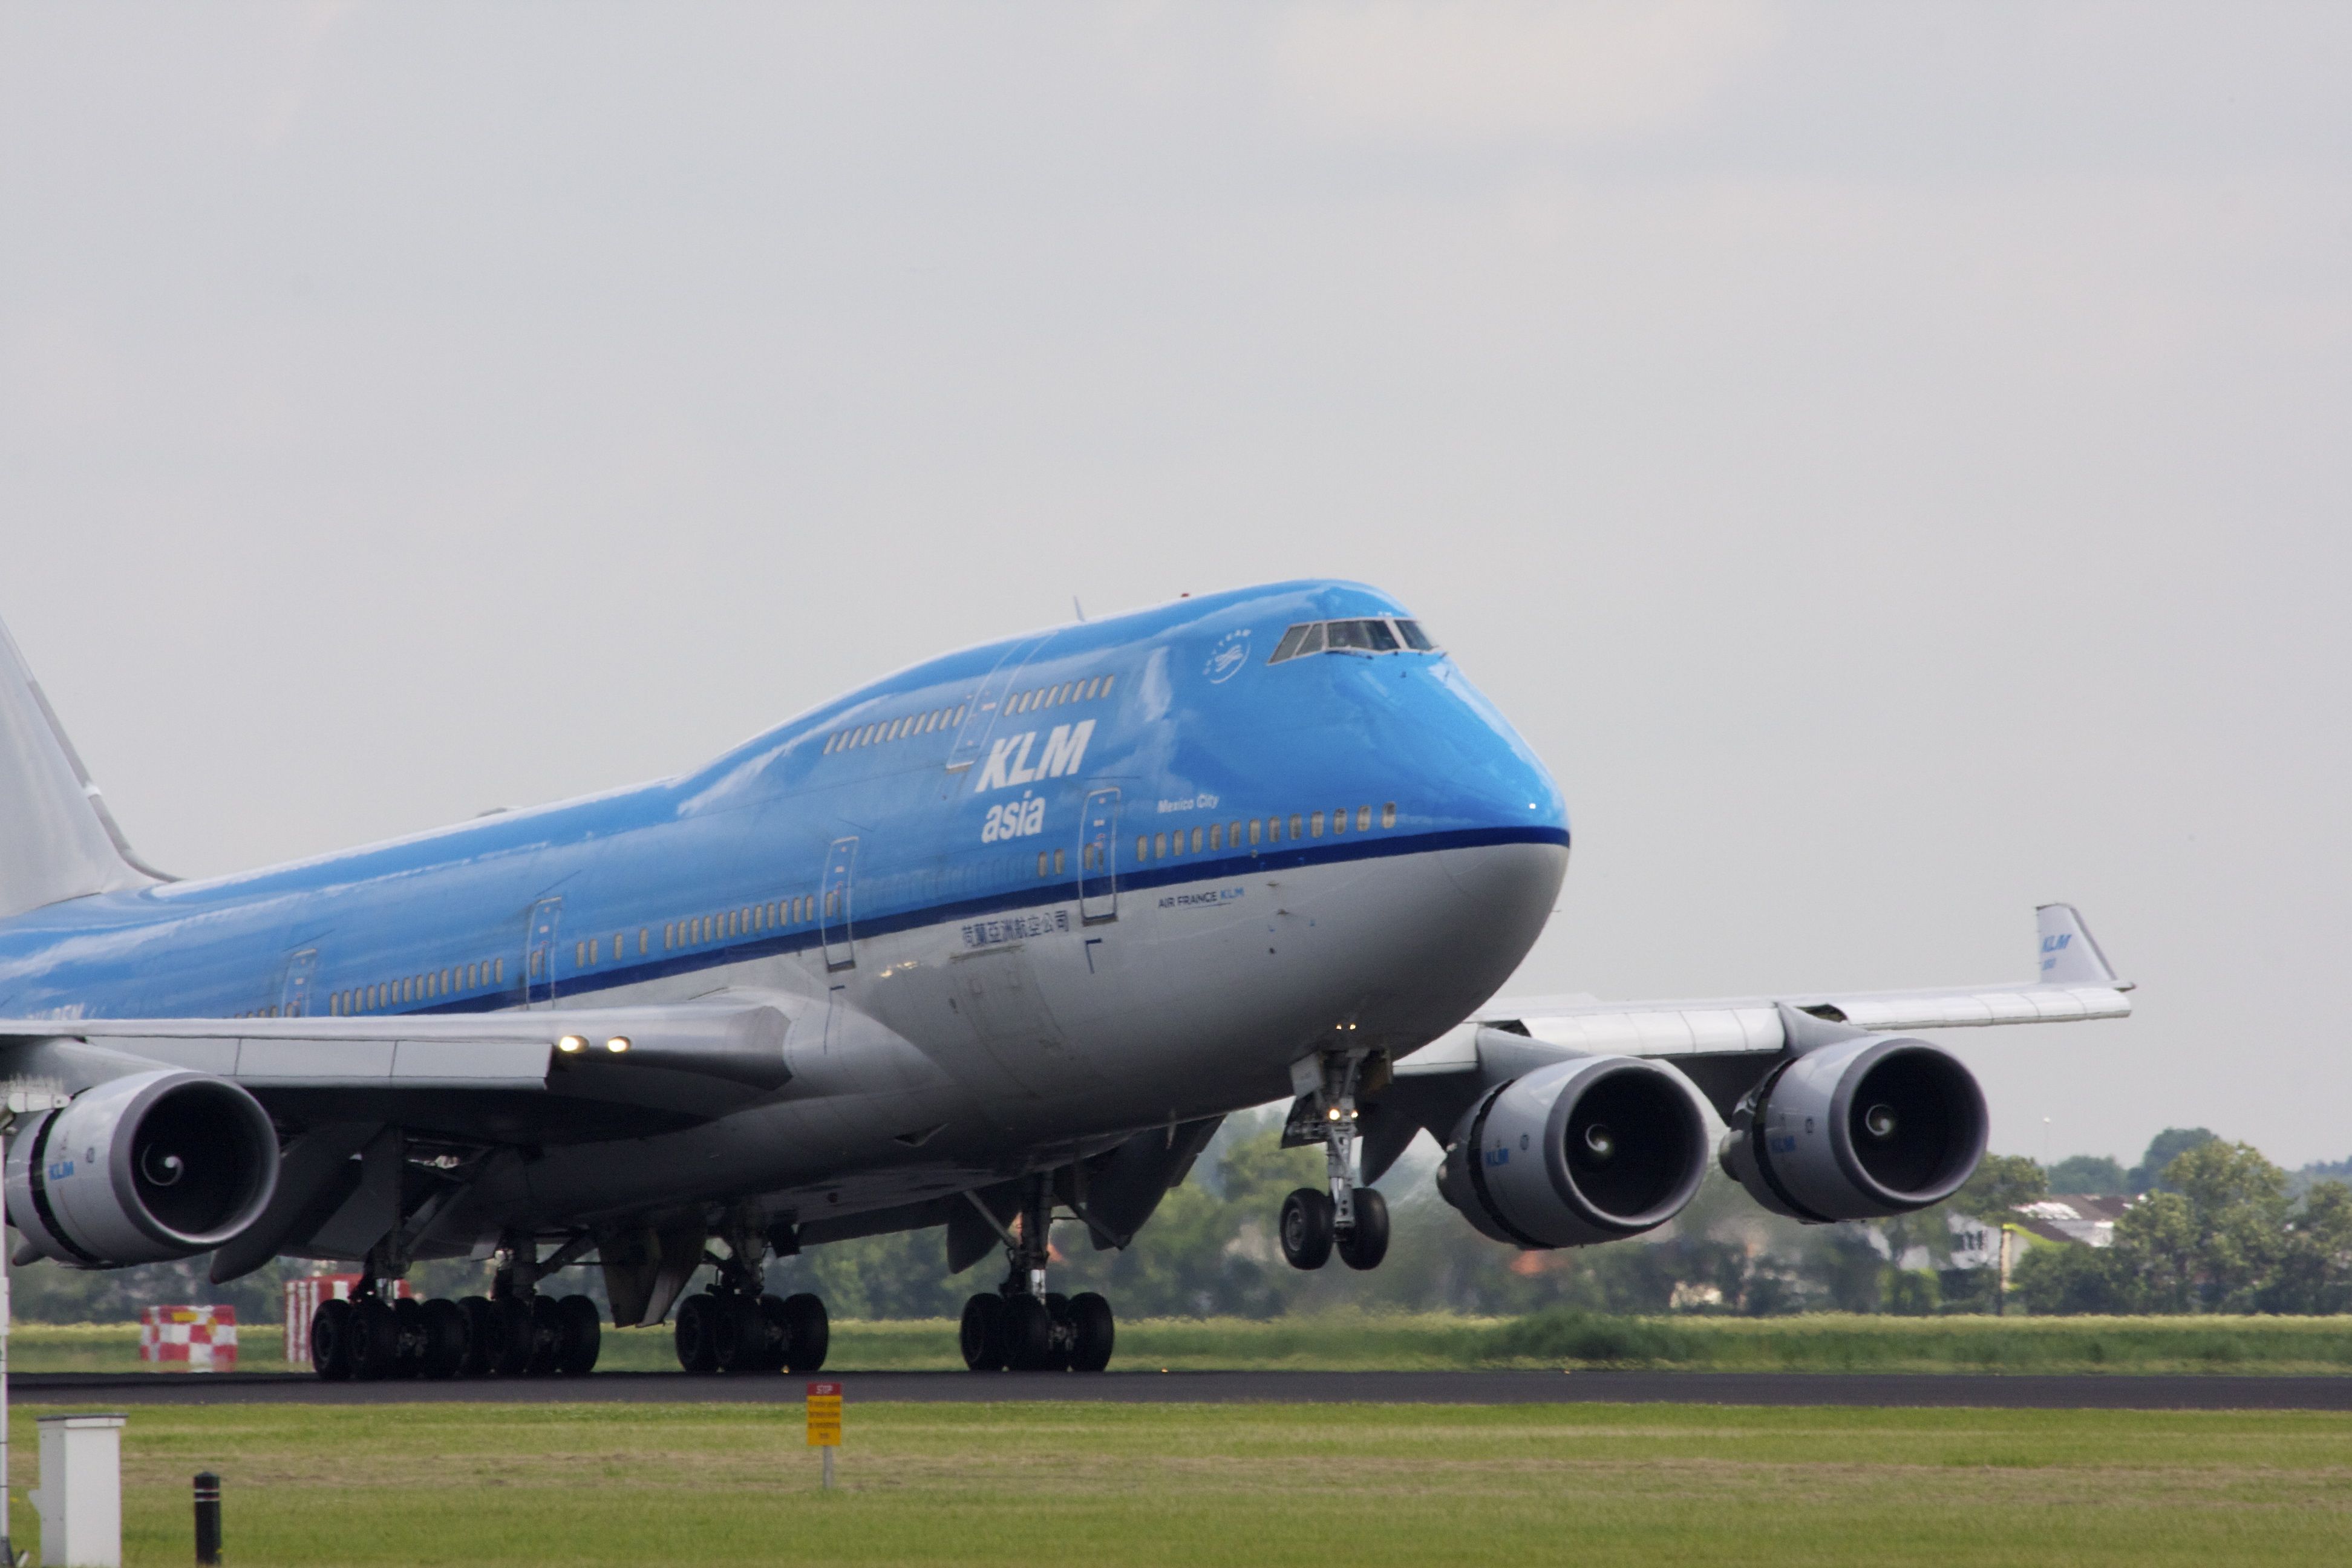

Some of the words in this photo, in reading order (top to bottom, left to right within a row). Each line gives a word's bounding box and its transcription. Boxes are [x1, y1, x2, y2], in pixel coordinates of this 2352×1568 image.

[975, 719, 1097, 793] KLM
[1157, 799, 1194, 813] Mexico
[1197, 794, 1220, 809] City
[981, 790, 1045, 843] asia
[1158, 897, 1175, 908] AIR
[1177, 891, 1217, 905] FRANCE
[1220, 887, 1244, 900] KLM
[49, 1160, 74, 1181] KLM
